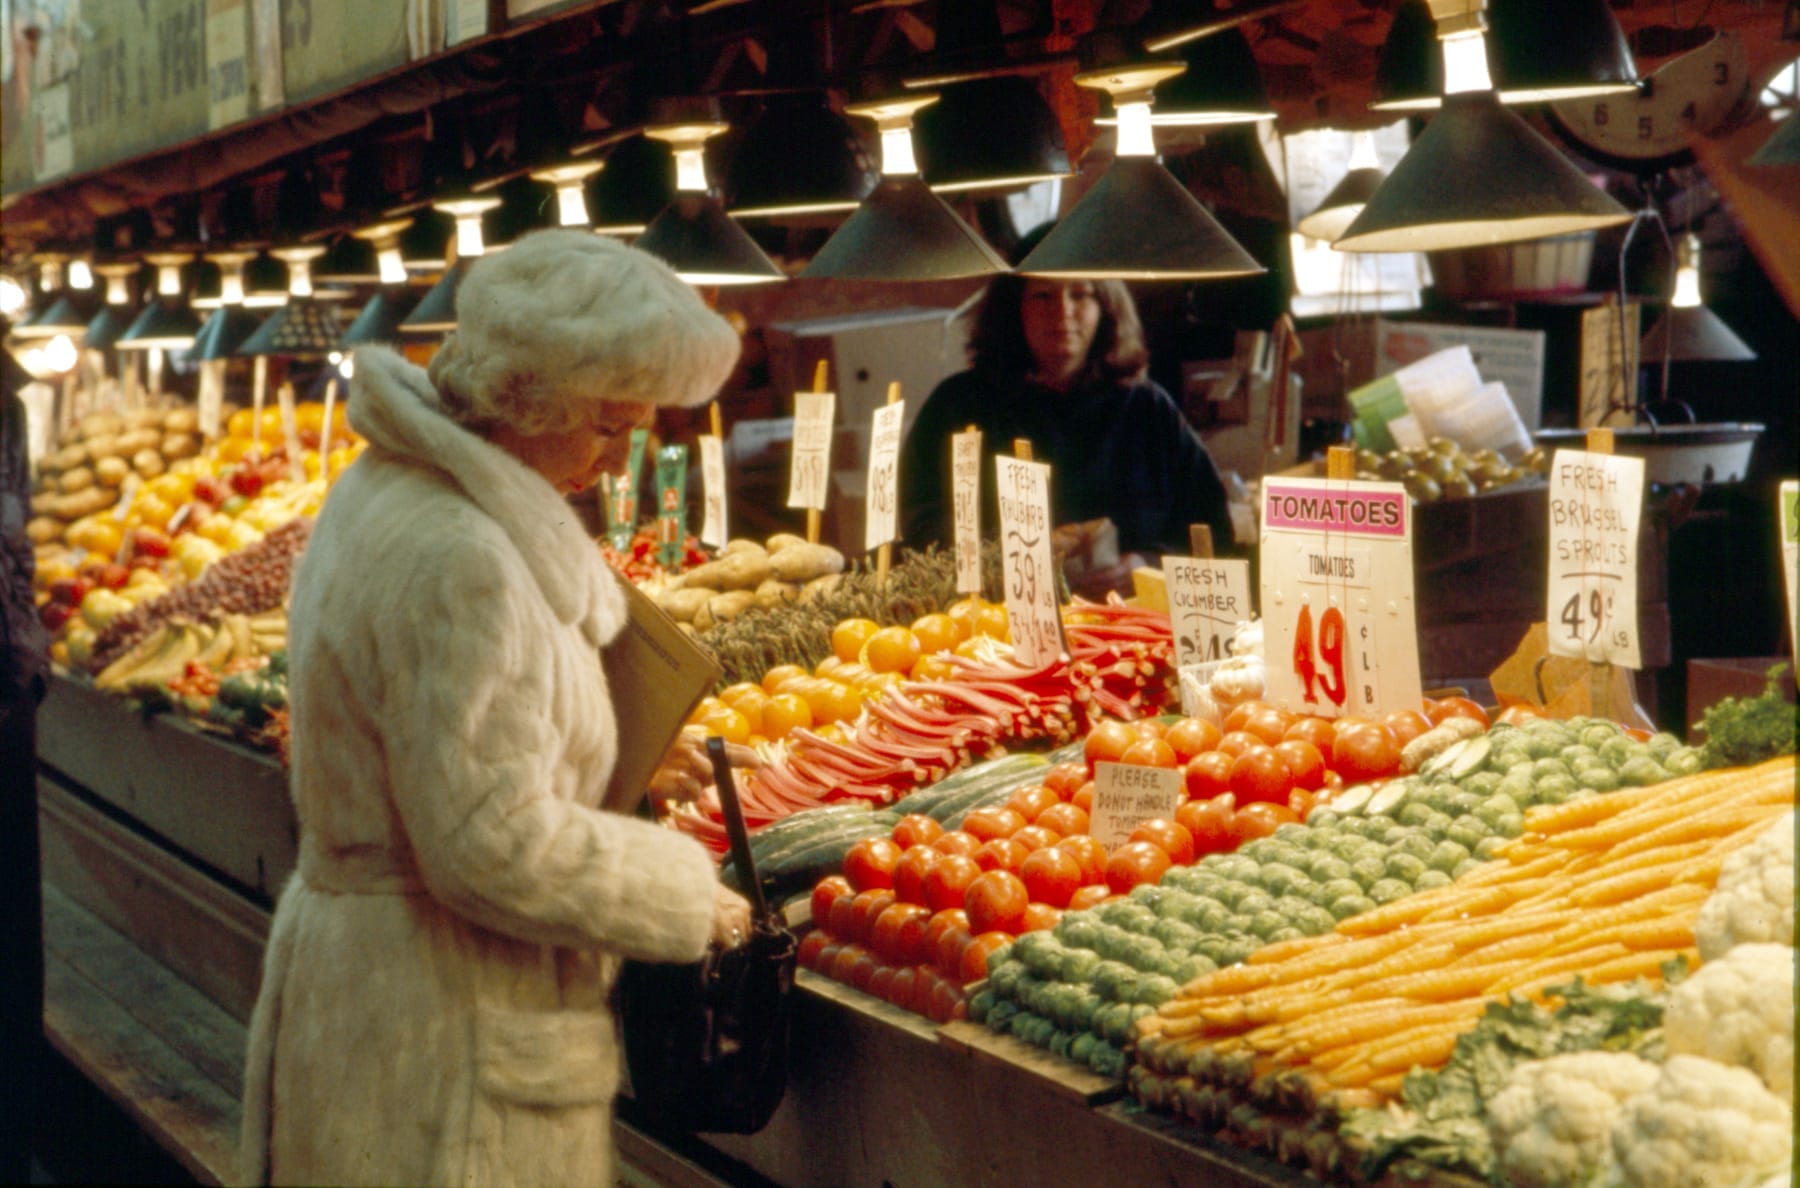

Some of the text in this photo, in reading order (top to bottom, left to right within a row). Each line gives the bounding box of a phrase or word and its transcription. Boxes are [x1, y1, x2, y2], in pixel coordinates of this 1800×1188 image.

[1714, 62, 1728, 85] 3
[1594, 104, 1608, 125] 6
[1682, 103, 1696, 121] 4
[1638, 118, 1652, 138] 5
[1561, 465, 1618, 493] FRESH
[1270, 495, 1400, 526] TOMATOES
[1557, 539, 1627, 564] SPROUTS
[1175, 565, 1228, 588] FRESH
[1309, 554, 1355, 579] TOMATOES
[1293, 604, 1347, 708] 49
[1112, 767, 1160, 789] PLEASE
